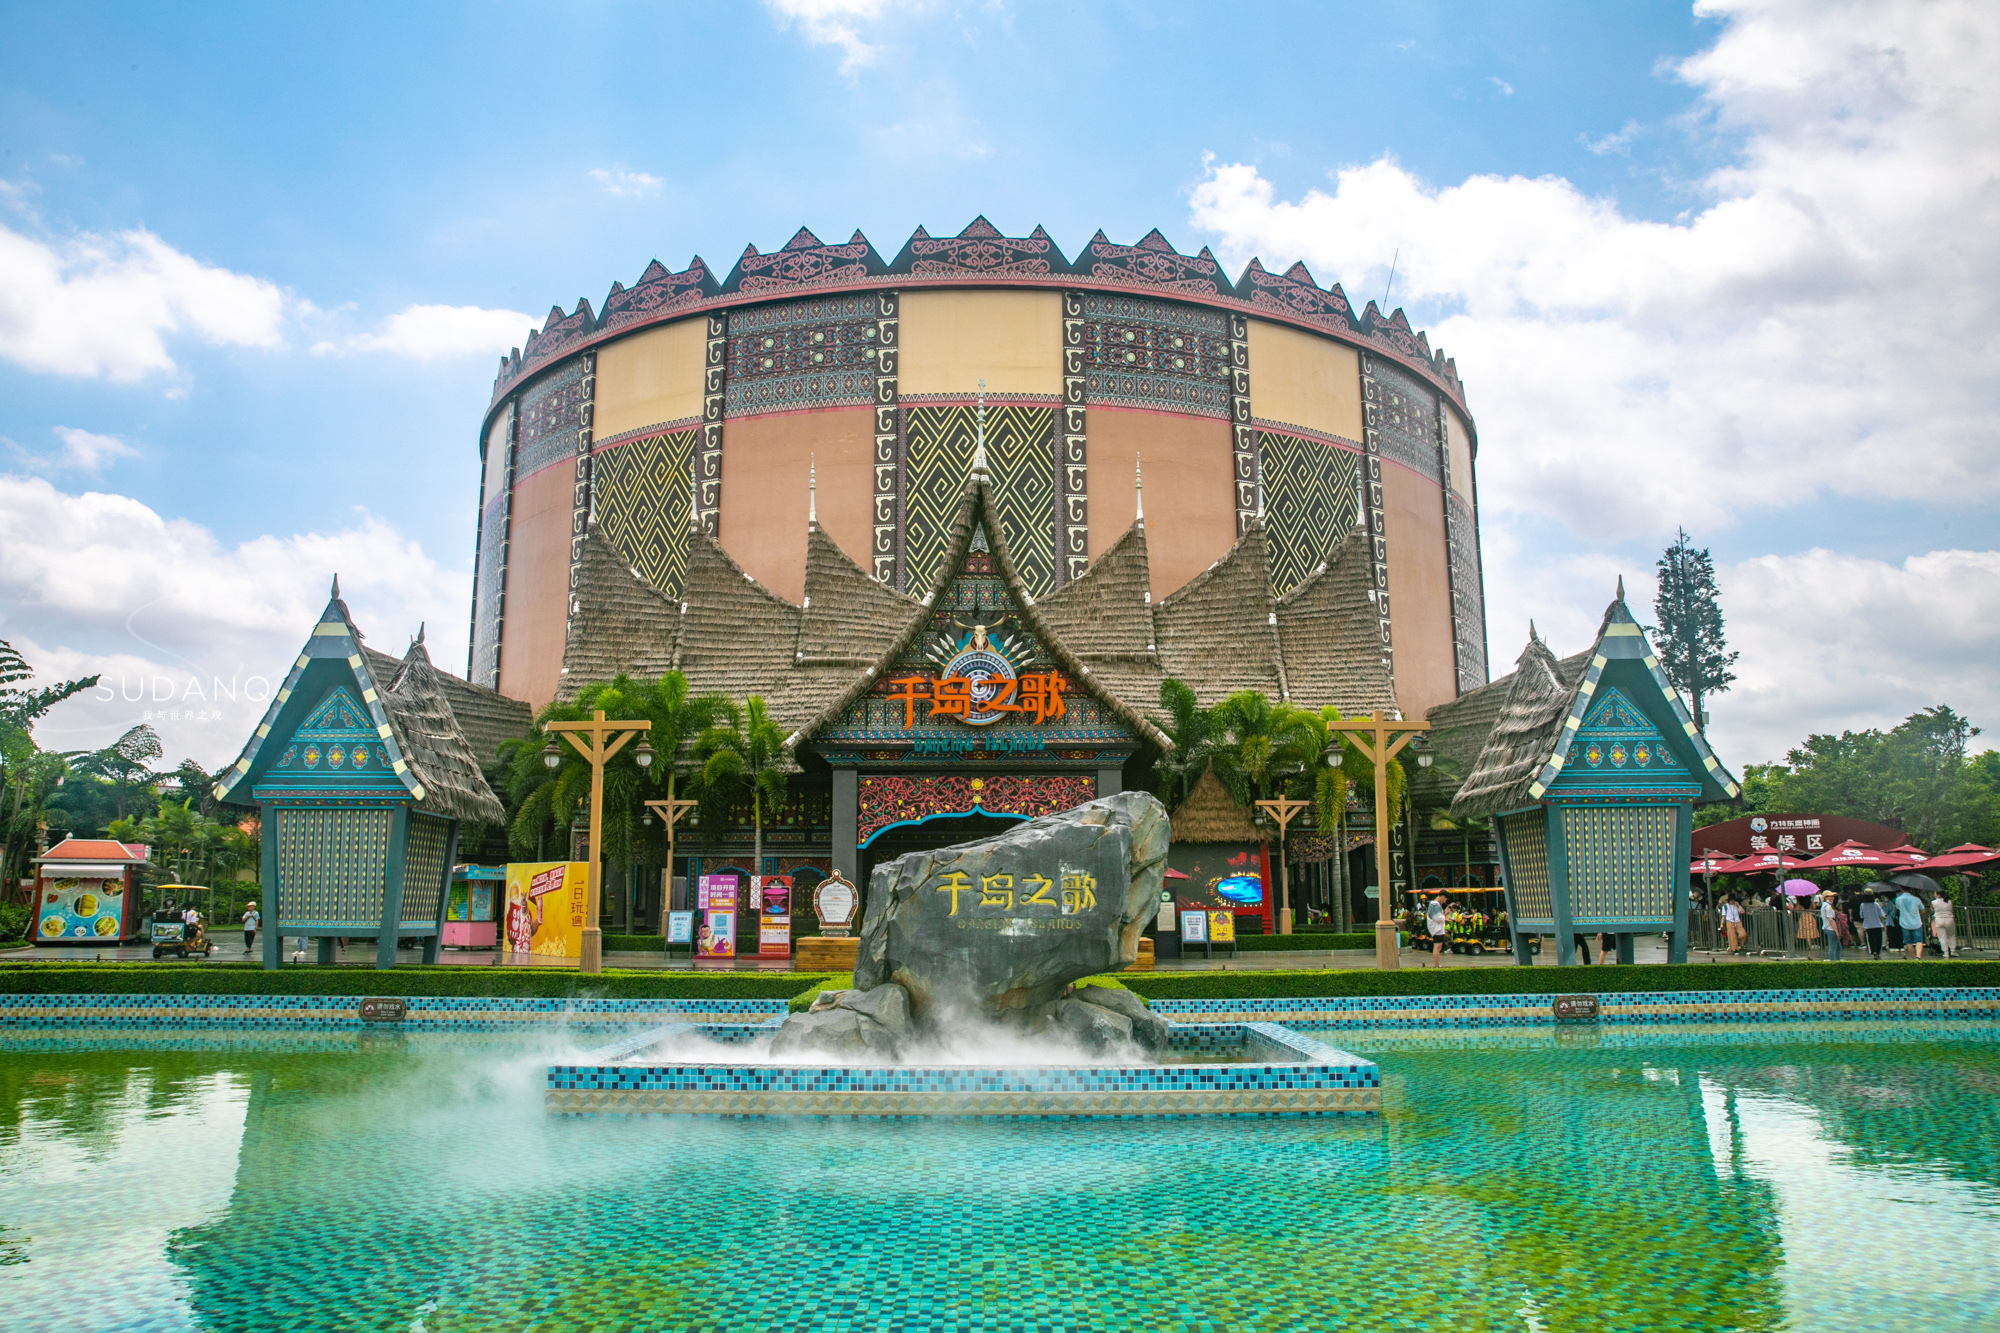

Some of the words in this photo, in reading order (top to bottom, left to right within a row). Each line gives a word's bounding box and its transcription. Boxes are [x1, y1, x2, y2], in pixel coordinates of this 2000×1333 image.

[885, 668, 1067, 731] 千岛之歌
[913, 738, 974, 755] DANCING
[985, 735, 1046, 755] ISLANDS
[1750, 834, 1824, 851] 等候区
[570, 880, 585, 928] 一日玩遍
[934, 867, 1098, 918] 千岛之歌
